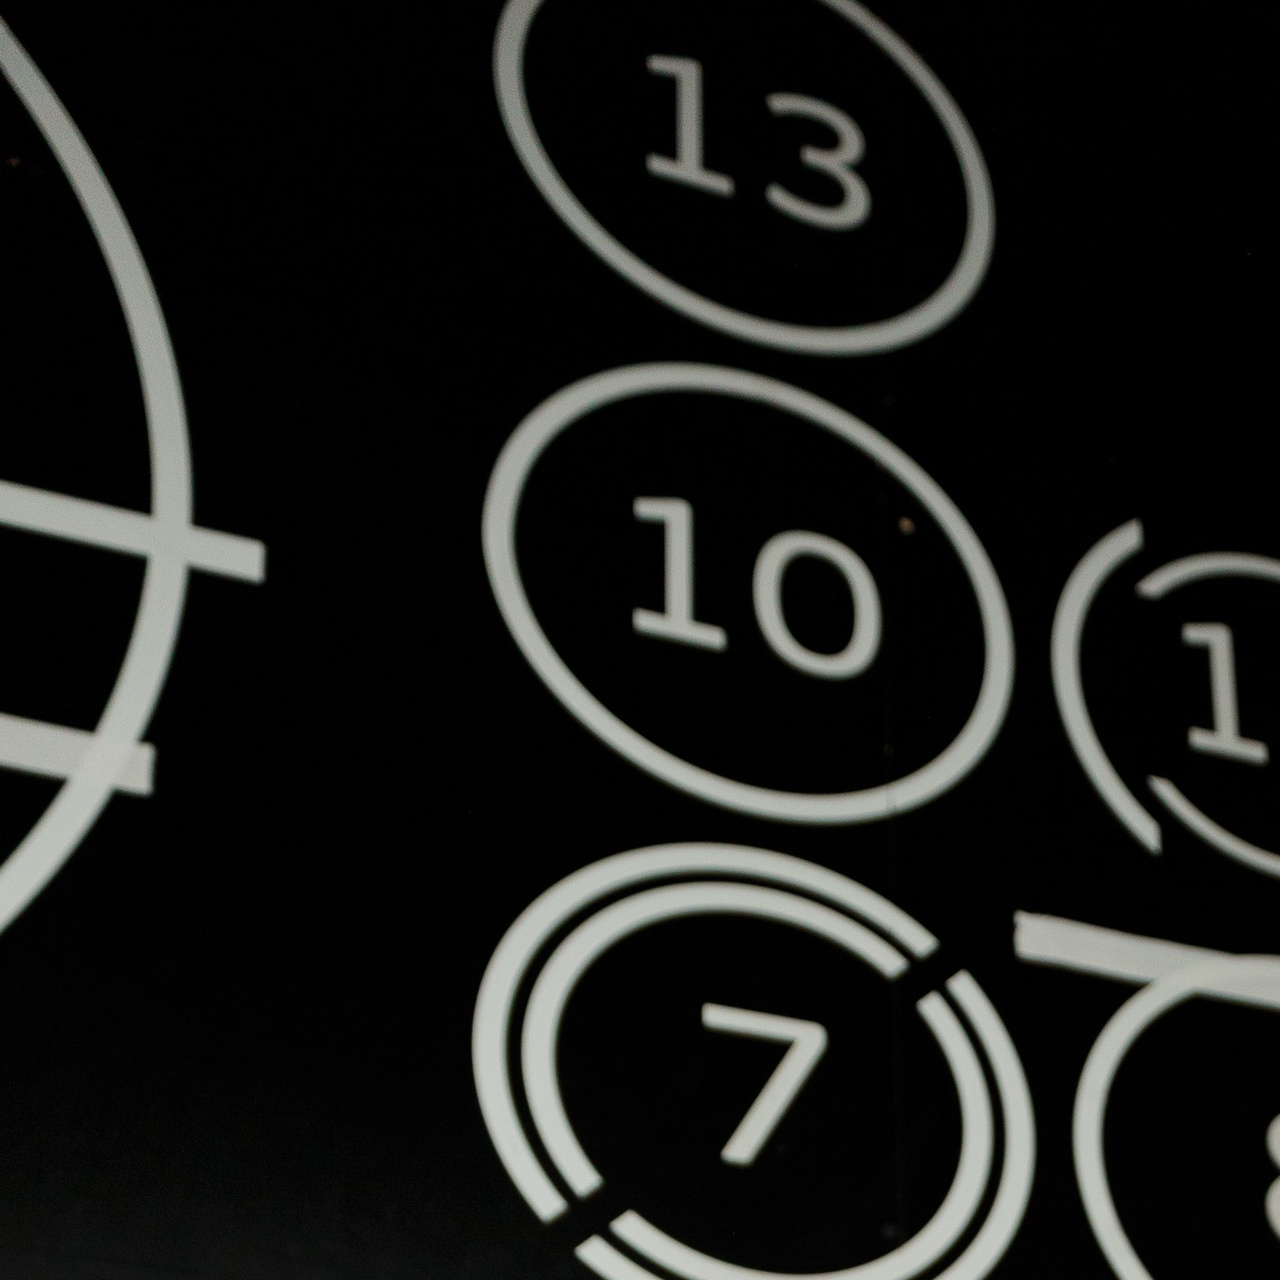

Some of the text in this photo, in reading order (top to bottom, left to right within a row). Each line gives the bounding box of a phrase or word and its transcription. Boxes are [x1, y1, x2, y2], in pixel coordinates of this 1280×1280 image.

[647, 55, 870, 229] 13
[632, 497, 882, 679] 10
[701, 1002, 828, 1165] 7
